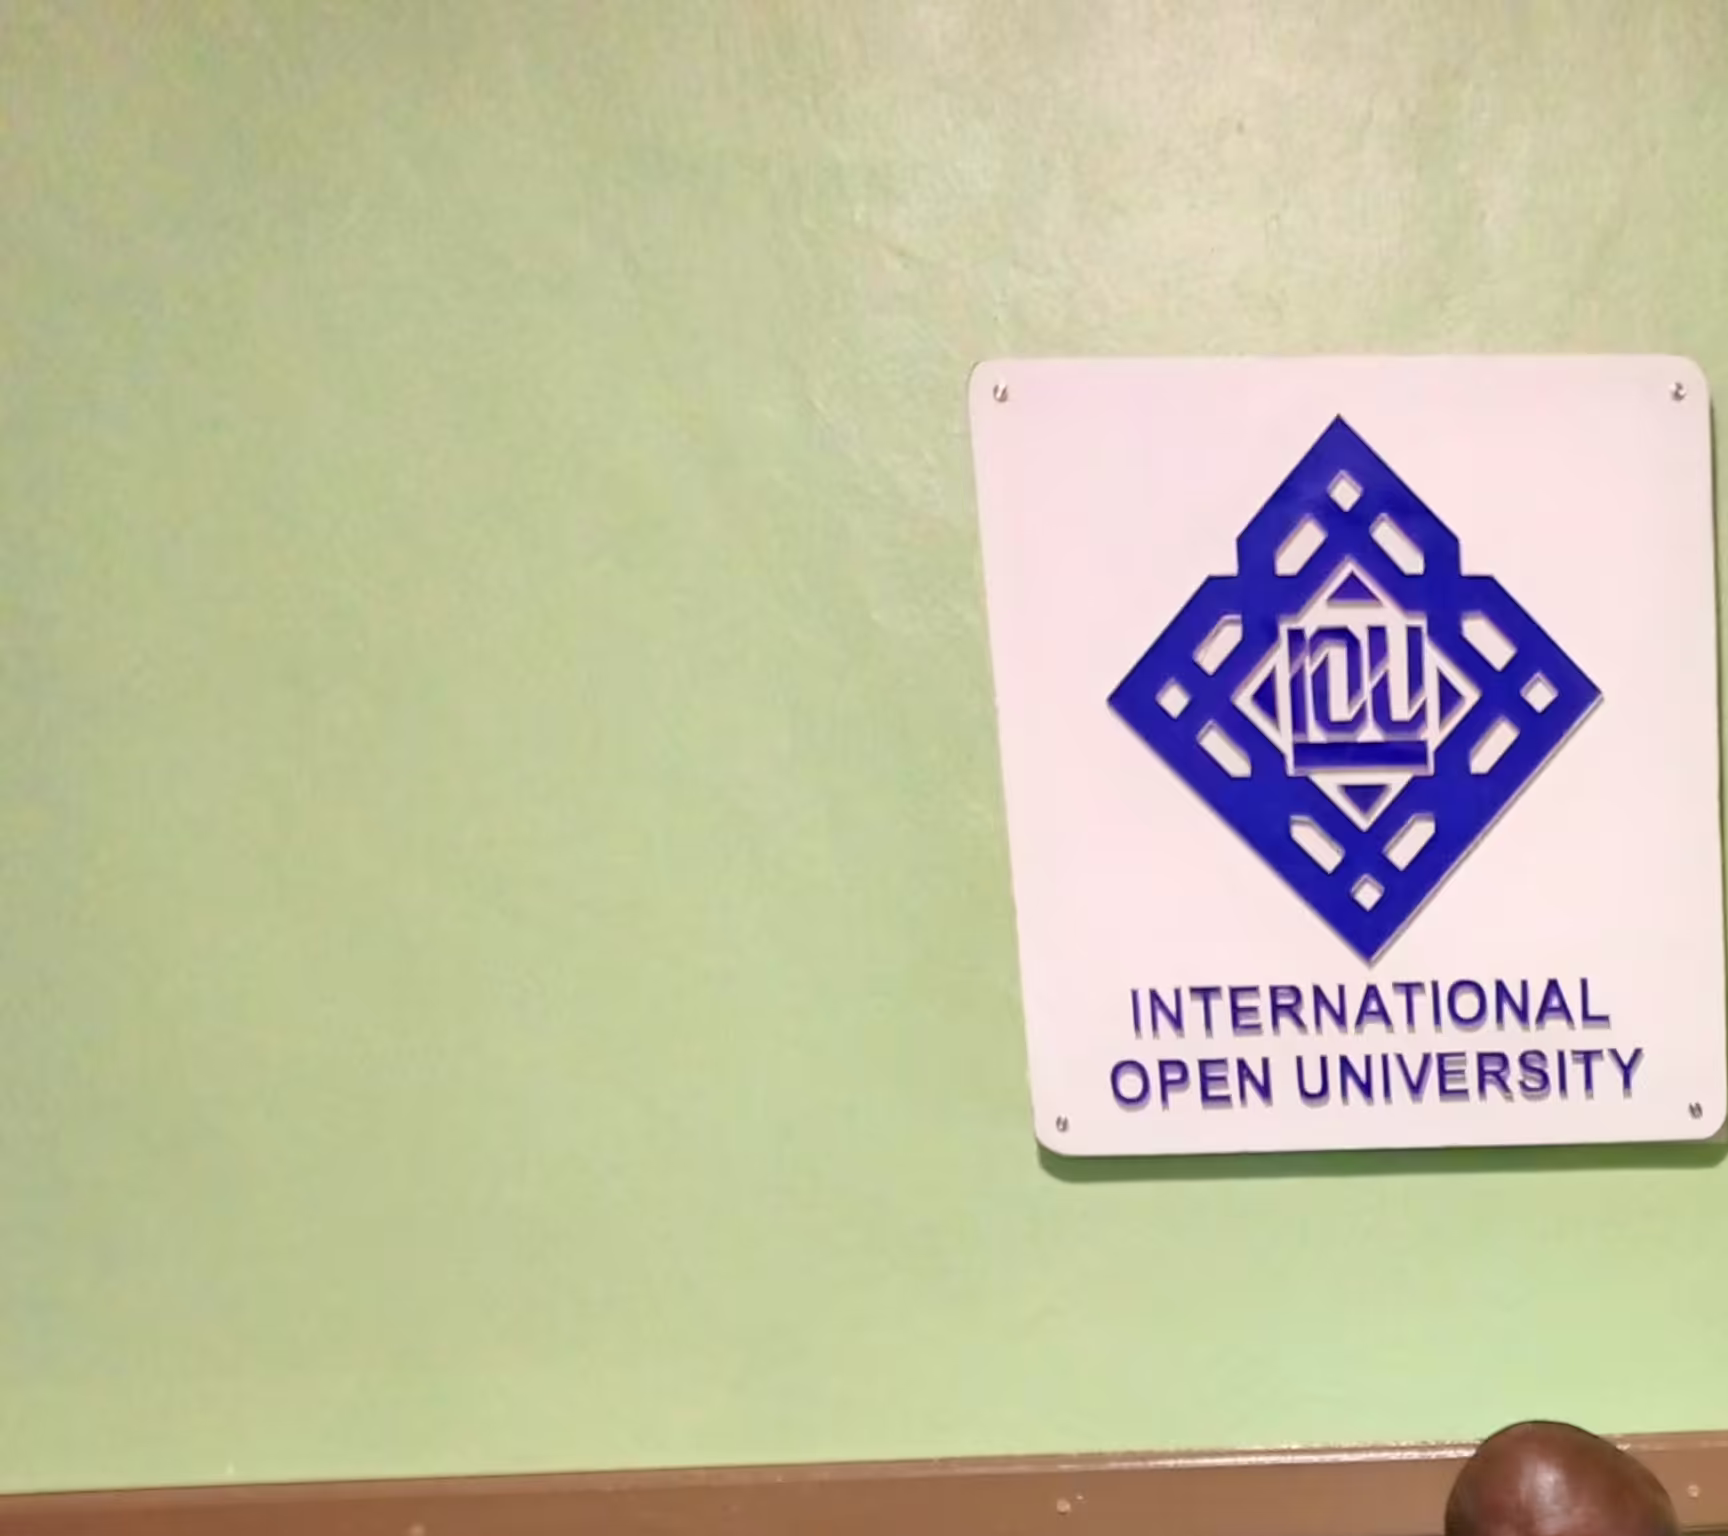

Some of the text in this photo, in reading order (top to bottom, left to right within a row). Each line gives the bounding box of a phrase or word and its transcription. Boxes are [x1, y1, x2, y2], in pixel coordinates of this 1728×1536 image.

[1130, 977, 1612, 1037] INTERNATIONAL
[1109, 1047, 1644, 1110] OPEN UNIVERSITY
